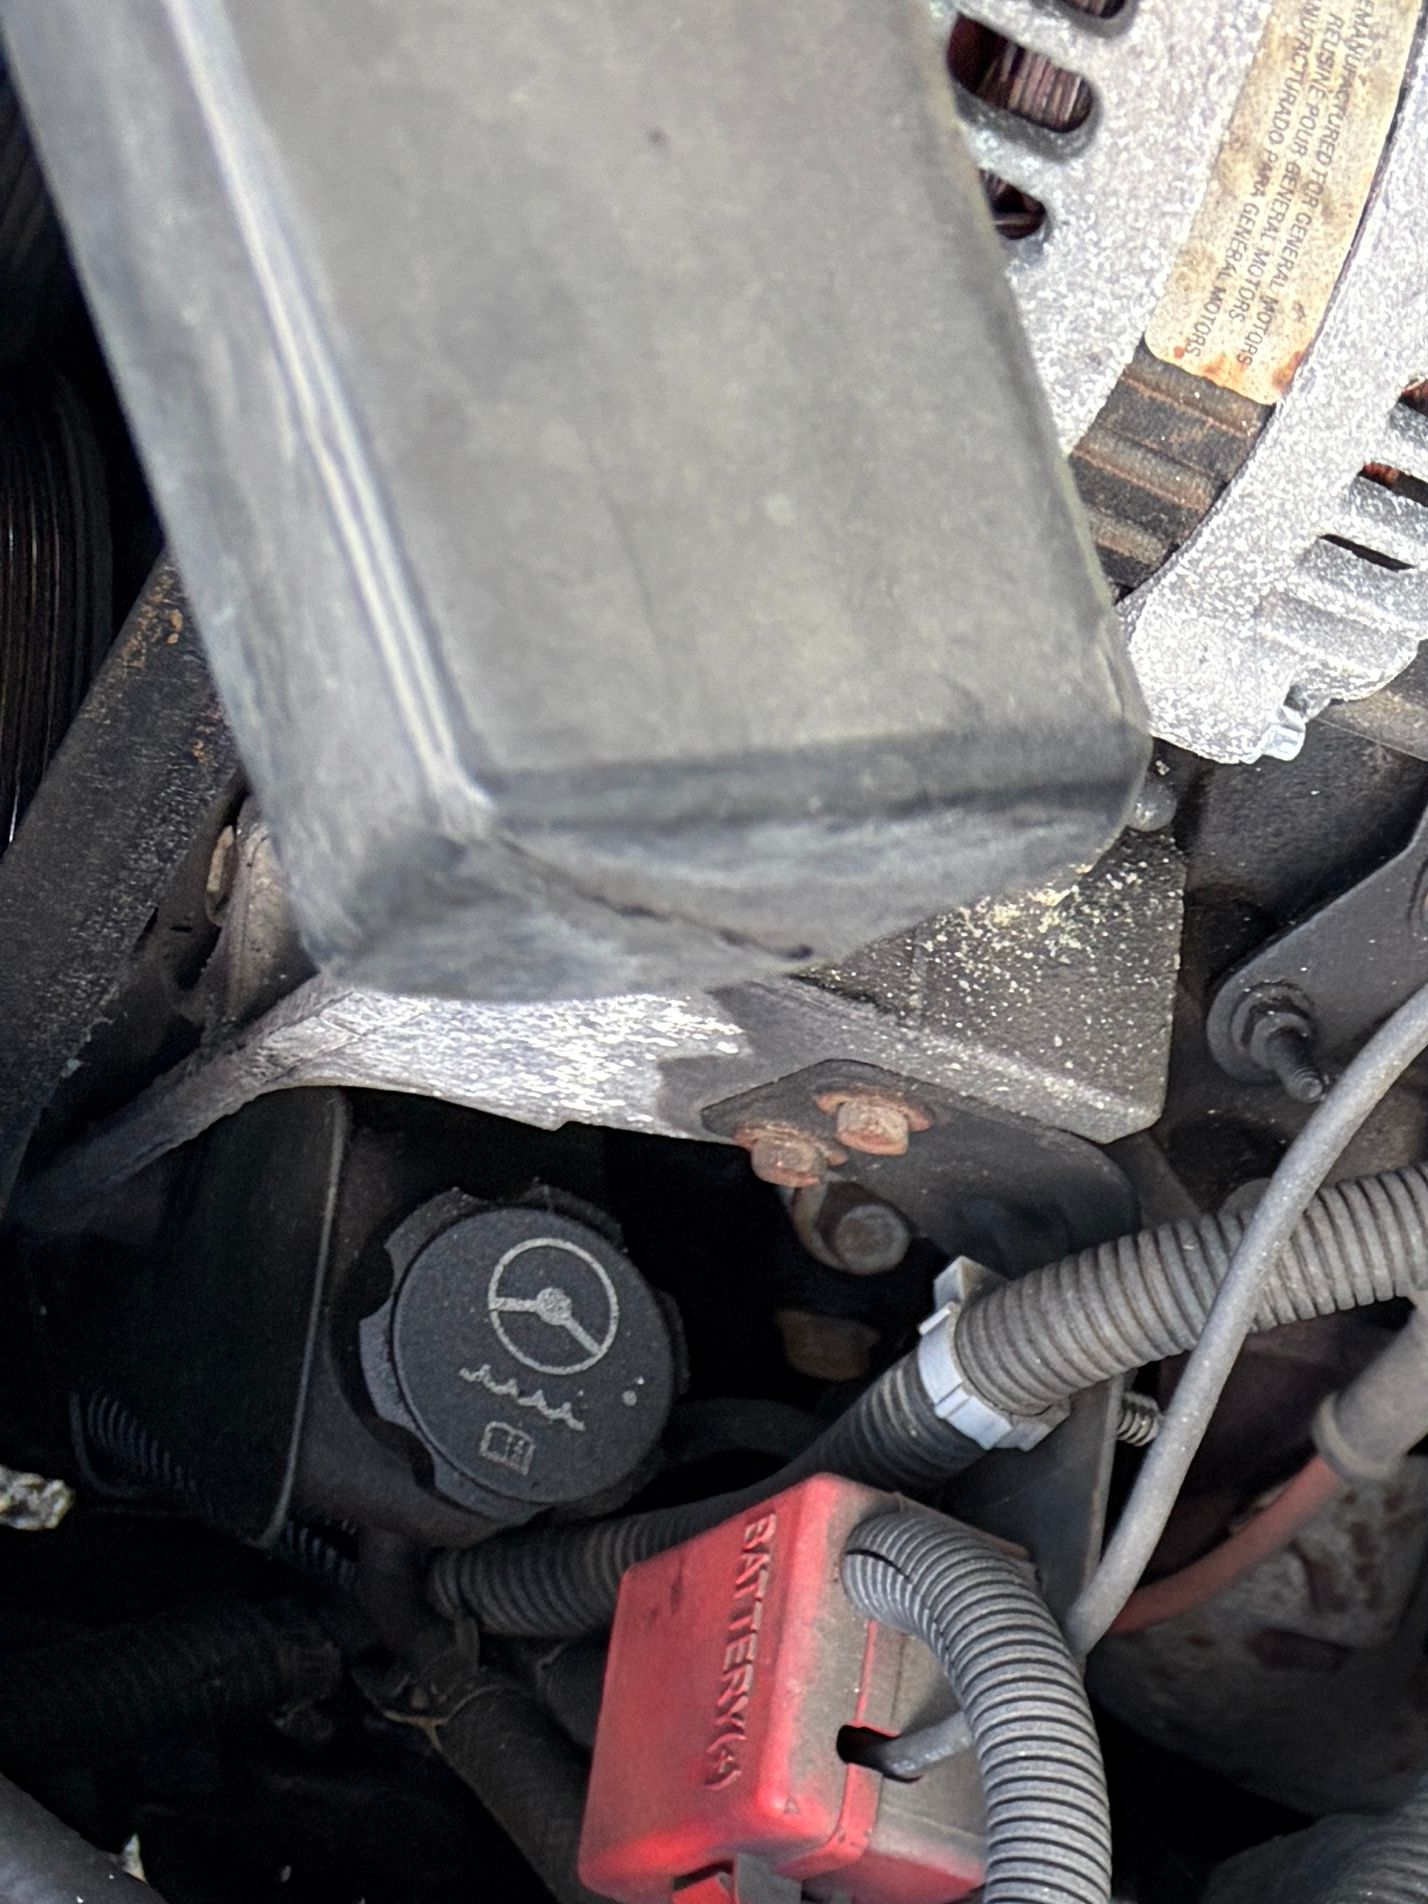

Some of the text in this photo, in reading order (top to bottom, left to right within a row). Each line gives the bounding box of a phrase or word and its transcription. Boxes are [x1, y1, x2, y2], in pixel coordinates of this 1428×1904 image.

[1288, 102, 1320, 156] POUR
[1250, 148, 1279, 197] PARA
[1260, 161, 1301, 240] GENERAL
[1302, 168, 1328, 208] FOR
[1216, 203, 1260, 280] GENERAL
[1269, 212, 1312, 288] GENERAL
[1229, 248, 1270, 322] MOTORS
[1185, 286, 1227, 357] MOTORS
[1237, 295, 1279, 366] MOTORS
